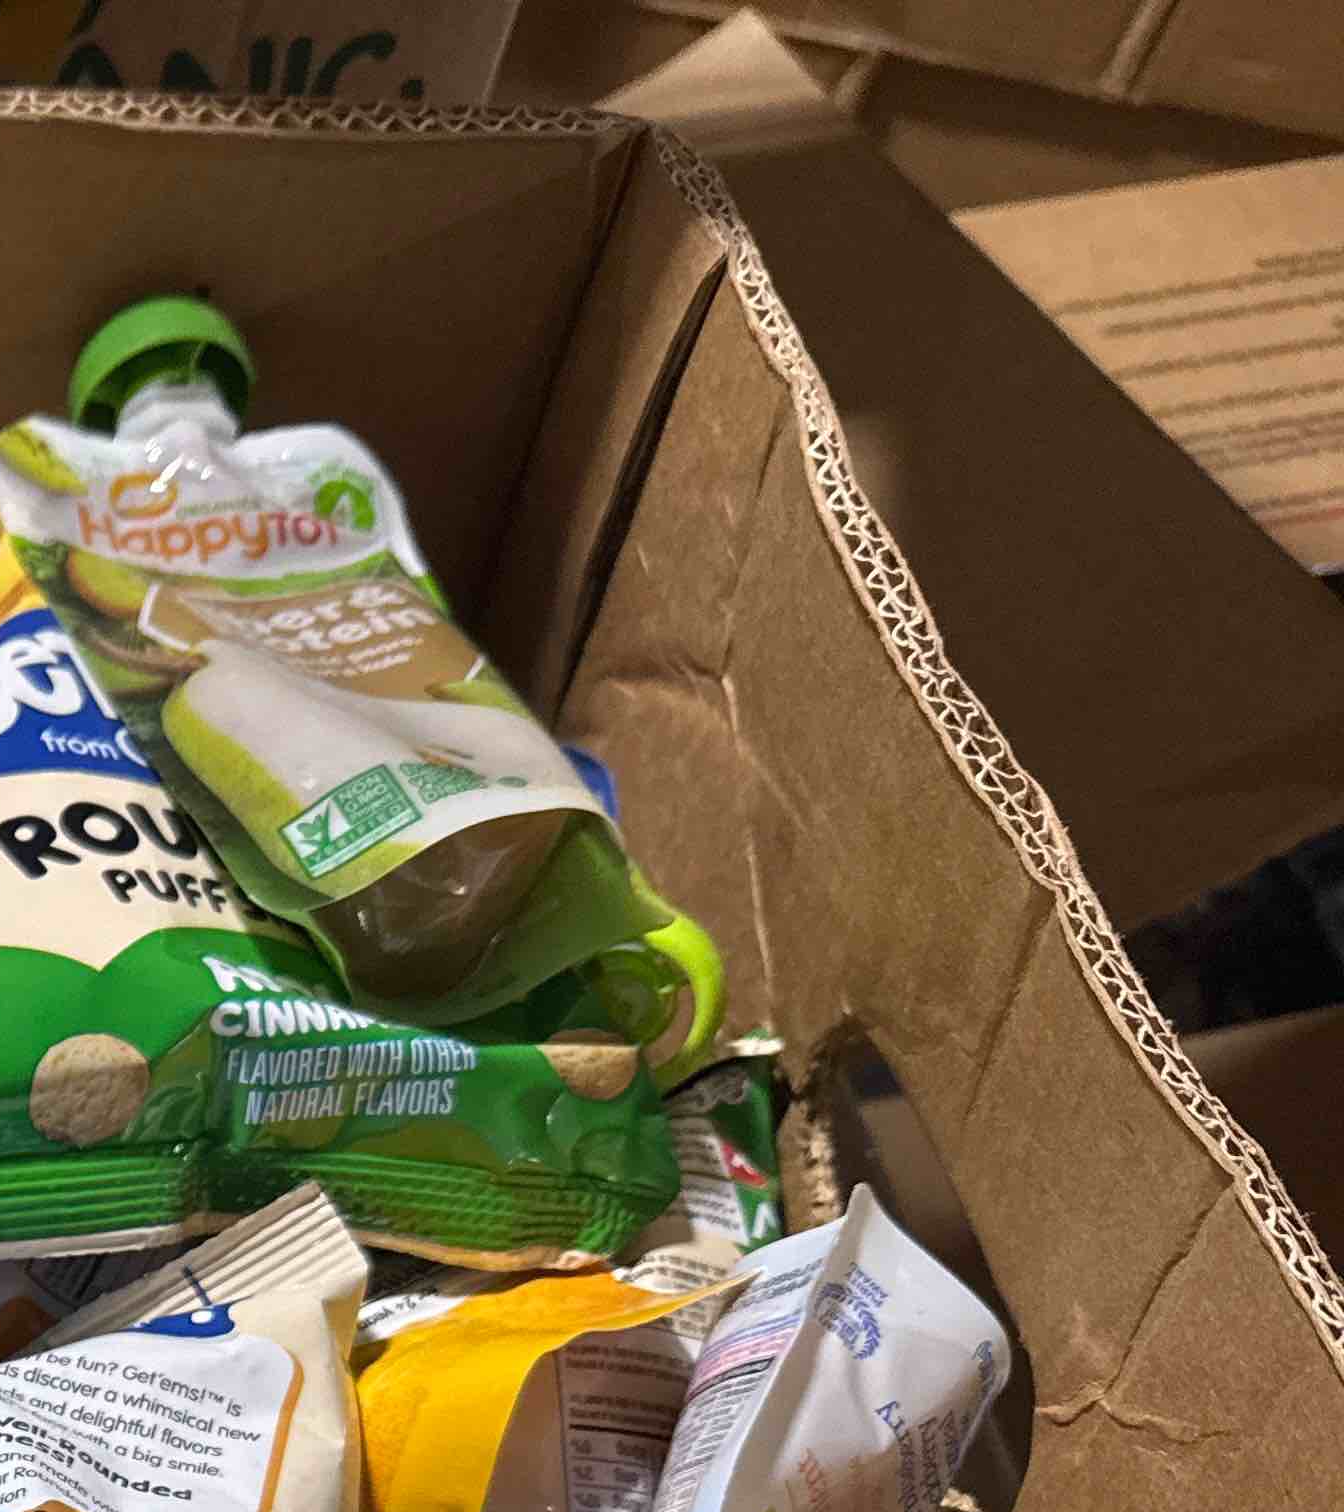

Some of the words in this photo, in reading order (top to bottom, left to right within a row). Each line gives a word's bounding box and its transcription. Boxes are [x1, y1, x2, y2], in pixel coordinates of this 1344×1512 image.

[39, 728, 116, 759] from
[226, 1045, 339, 1086] FLAVORED
[346, 1043, 403, 1076] WITH
[411, 1041, 476, 1073] OTHER
[244, 1087, 348, 1126] NATURAL
[354, 1079, 454, 1118] FLAVORS
[23, 1368, 100, 1401] discover
[103, 1386, 118, 1402] a
[122, 1391, 214, 1435] whimsical
[217, 1424, 261, 1444] new
[46, 1350, 71, 1367] be
[76, 1357, 117, 1379] fun?
[226, 1398, 242, 1418] is
[29, 1396, 64, 1417] and
[69, 1403, 158, 1443] delightful
[160, 1426, 223, 1458] flavors
